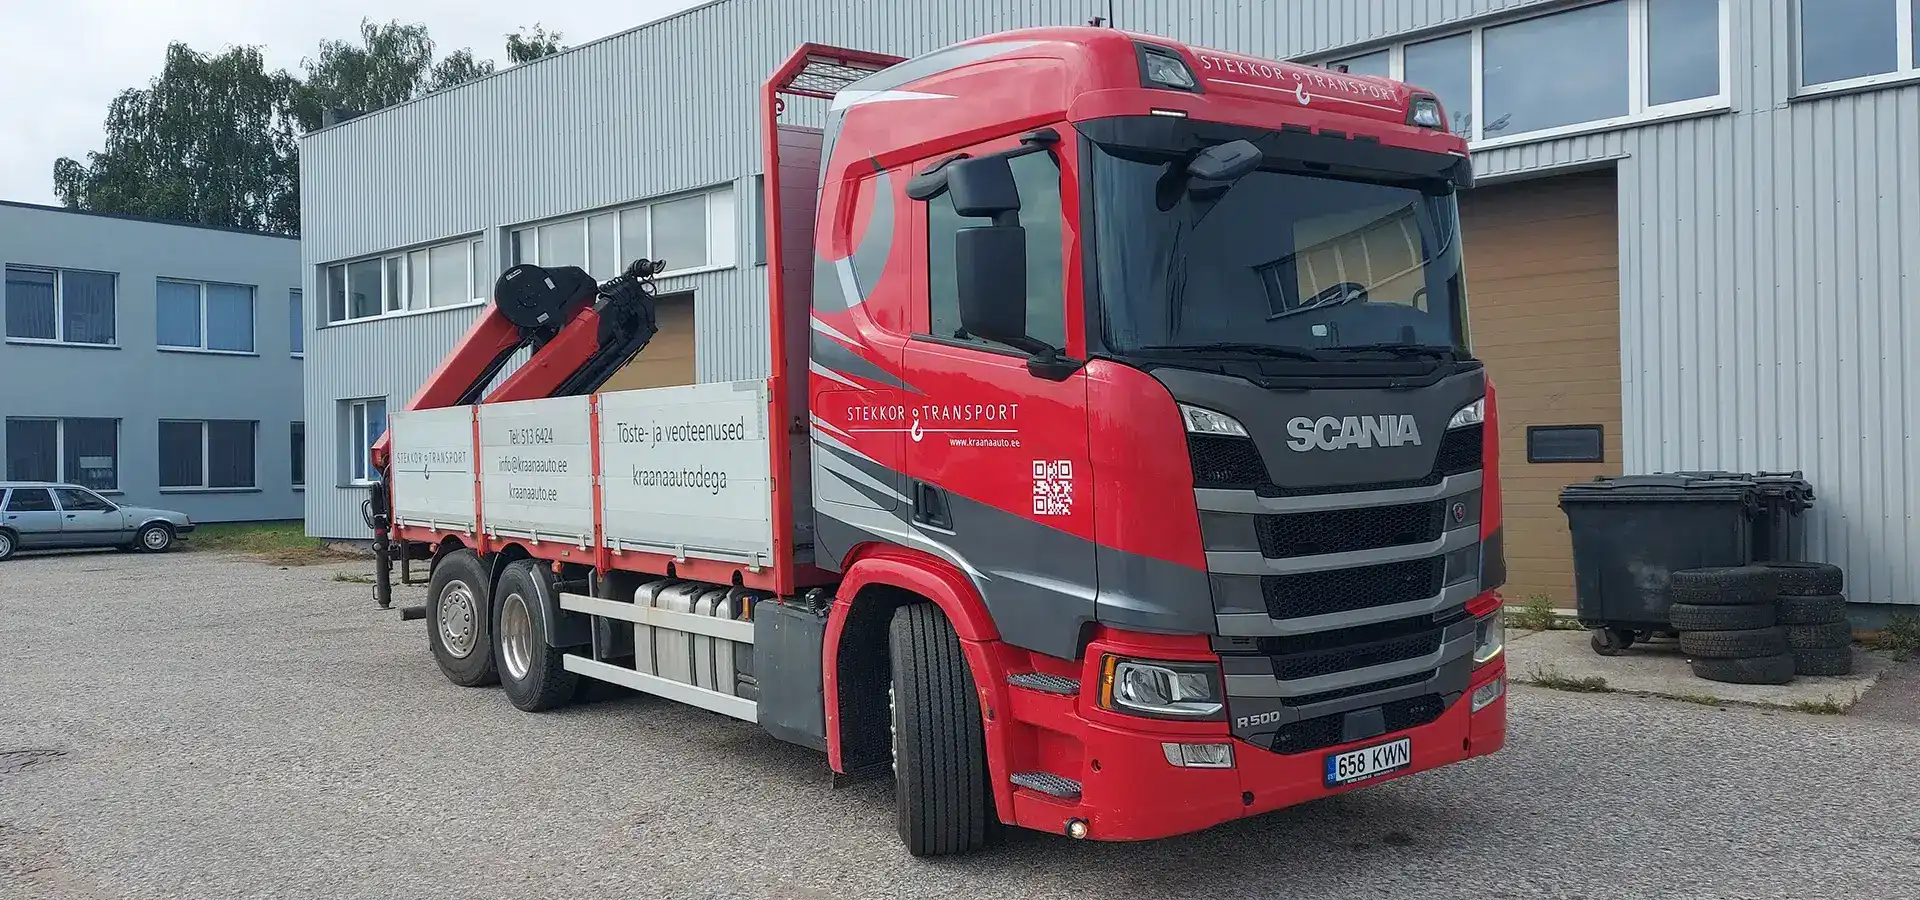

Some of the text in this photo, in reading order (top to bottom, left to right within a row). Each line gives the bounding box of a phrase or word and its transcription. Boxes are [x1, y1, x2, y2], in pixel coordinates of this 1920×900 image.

[1200, 54, 1398, 103] STEKKOR TRANSPORT
[847, 403, 1019, 421] STEKKOR TRANSPORT
[521, 427, 534, 445] 513
[535, 427, 553, 444] 6424
[617, 415, 744, 449] Tõste- ja veoteenused
[1286, 414, 1422, 452] SCANIA
[949, 436, 1021, 448] www.kraanaauto.ee
[396, 450, 467, 464] STEKKOR TRANSPORT
[498, 455, 568, 474] info@kraanaauto.ee
[632, 463, 727, 495] kraanaautodega
[508, 482, 557, 501] kraanaauto.ee
[1338, 752, 1366, 778] 658
[1372, 741, 1408, 770] KWN
